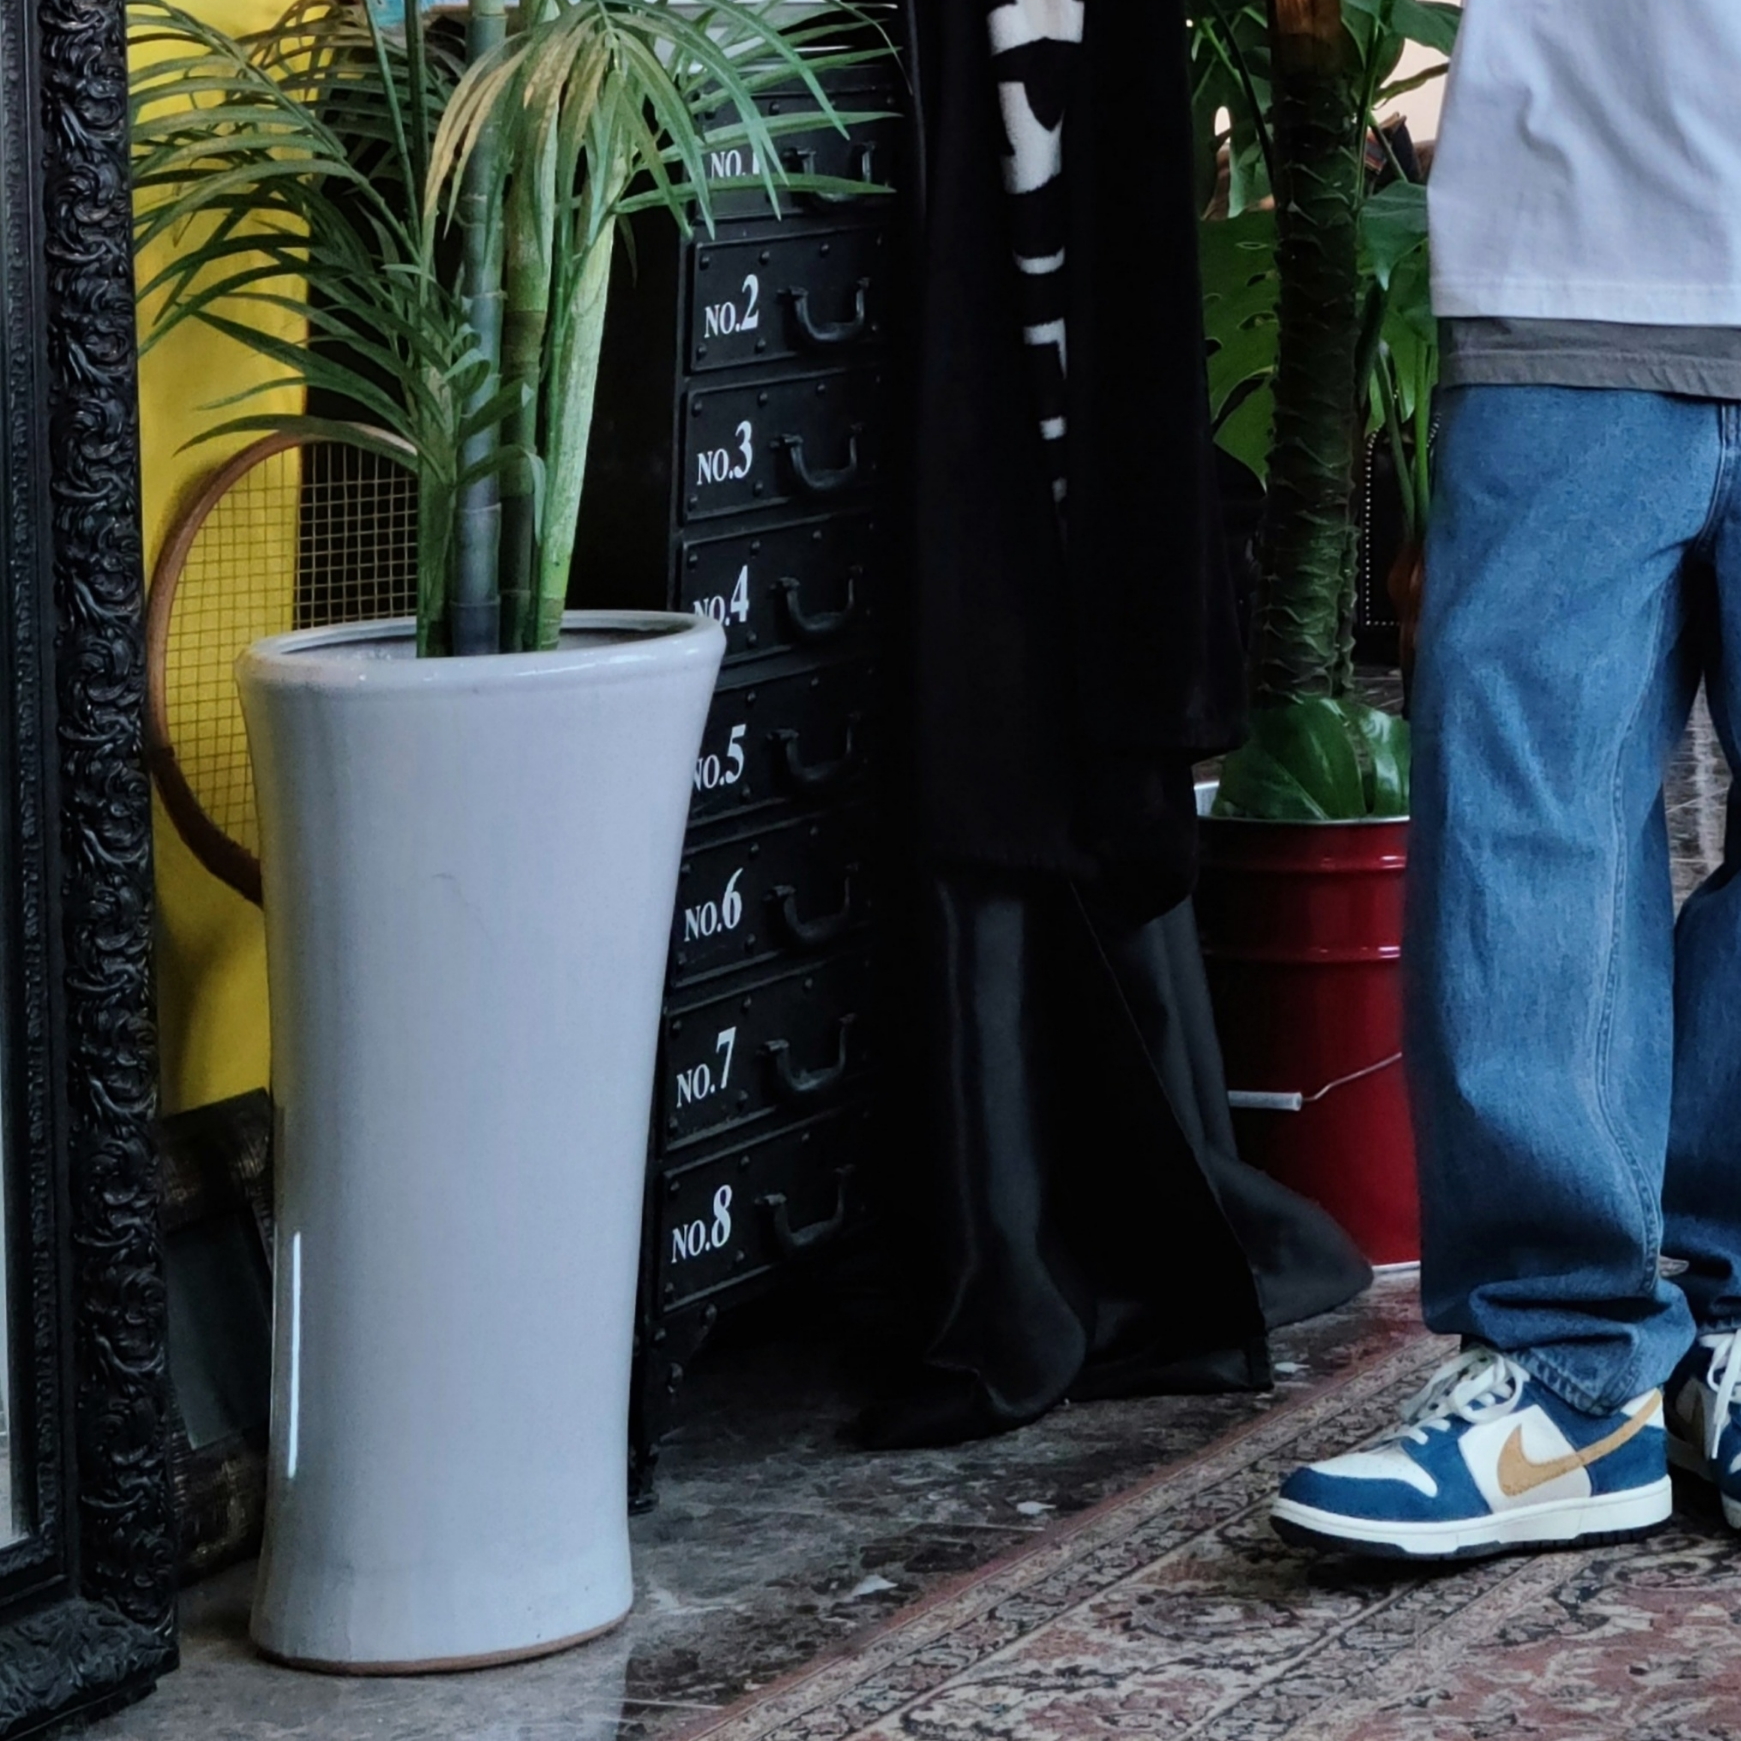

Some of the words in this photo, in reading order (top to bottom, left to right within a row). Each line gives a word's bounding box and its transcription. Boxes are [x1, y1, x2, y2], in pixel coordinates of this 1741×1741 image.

[704, 273, 759, 338] NO.2
[696, 420, 753, 485] NO.3
[684, 867, 744, 942] NO.6
[676, 1025, 737, 1108] NO.7
[671, 1184, 733, 1264] NO.8
